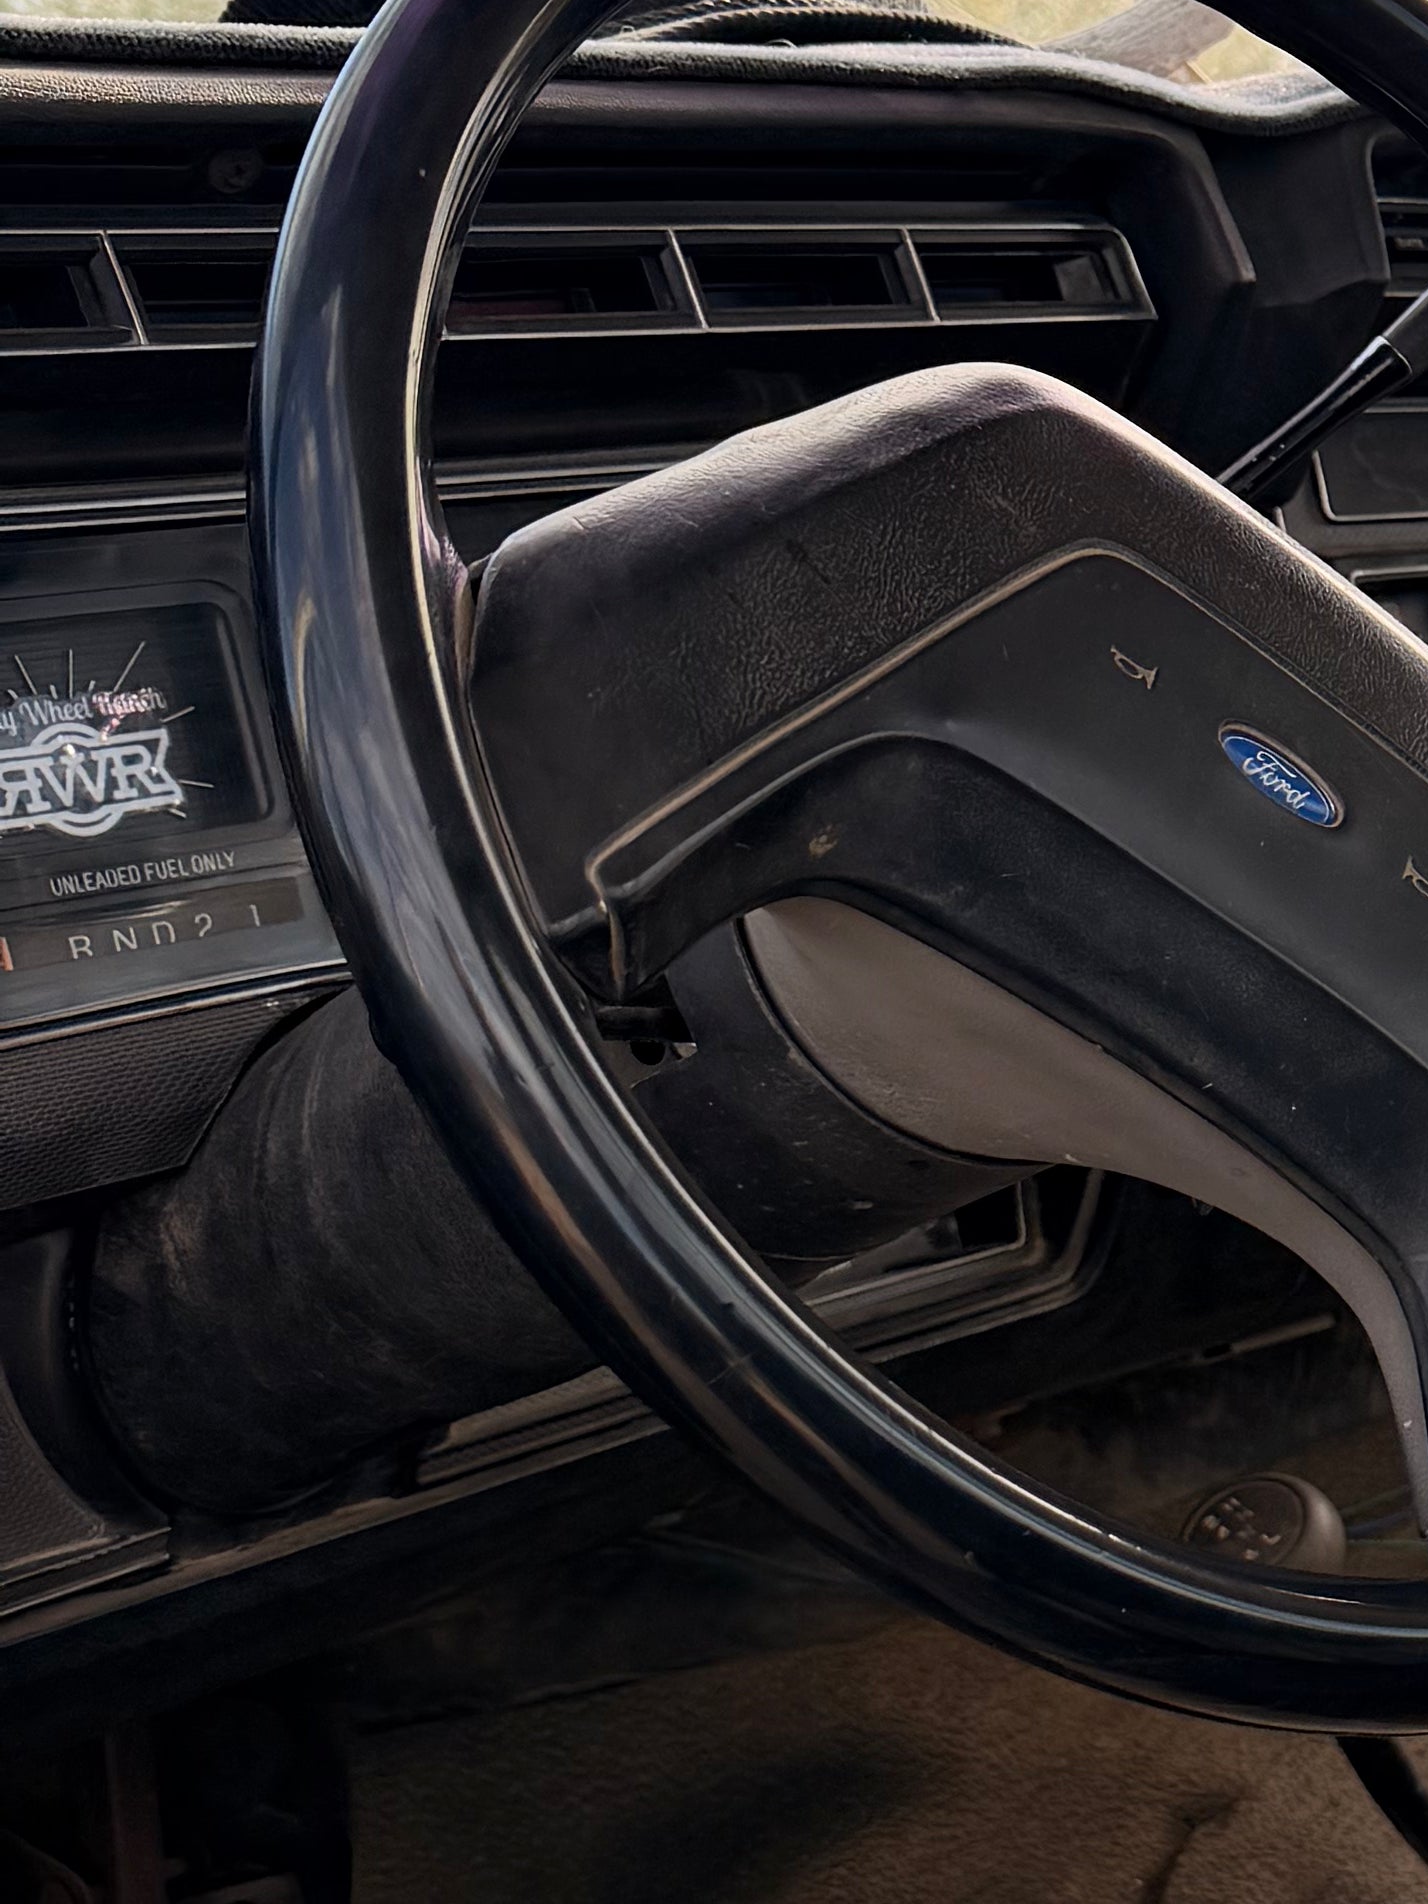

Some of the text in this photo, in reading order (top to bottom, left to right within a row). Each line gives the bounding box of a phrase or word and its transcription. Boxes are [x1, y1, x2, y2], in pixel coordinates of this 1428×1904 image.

[19, 697, 94, 725] Wheel
[1242, 750, 1311, 810] Ford
[50, 851, 236, 896] UNLEADED FUEL ONLY
[68, 934, 94, 960] R
[112, 926, 138, 953] N
